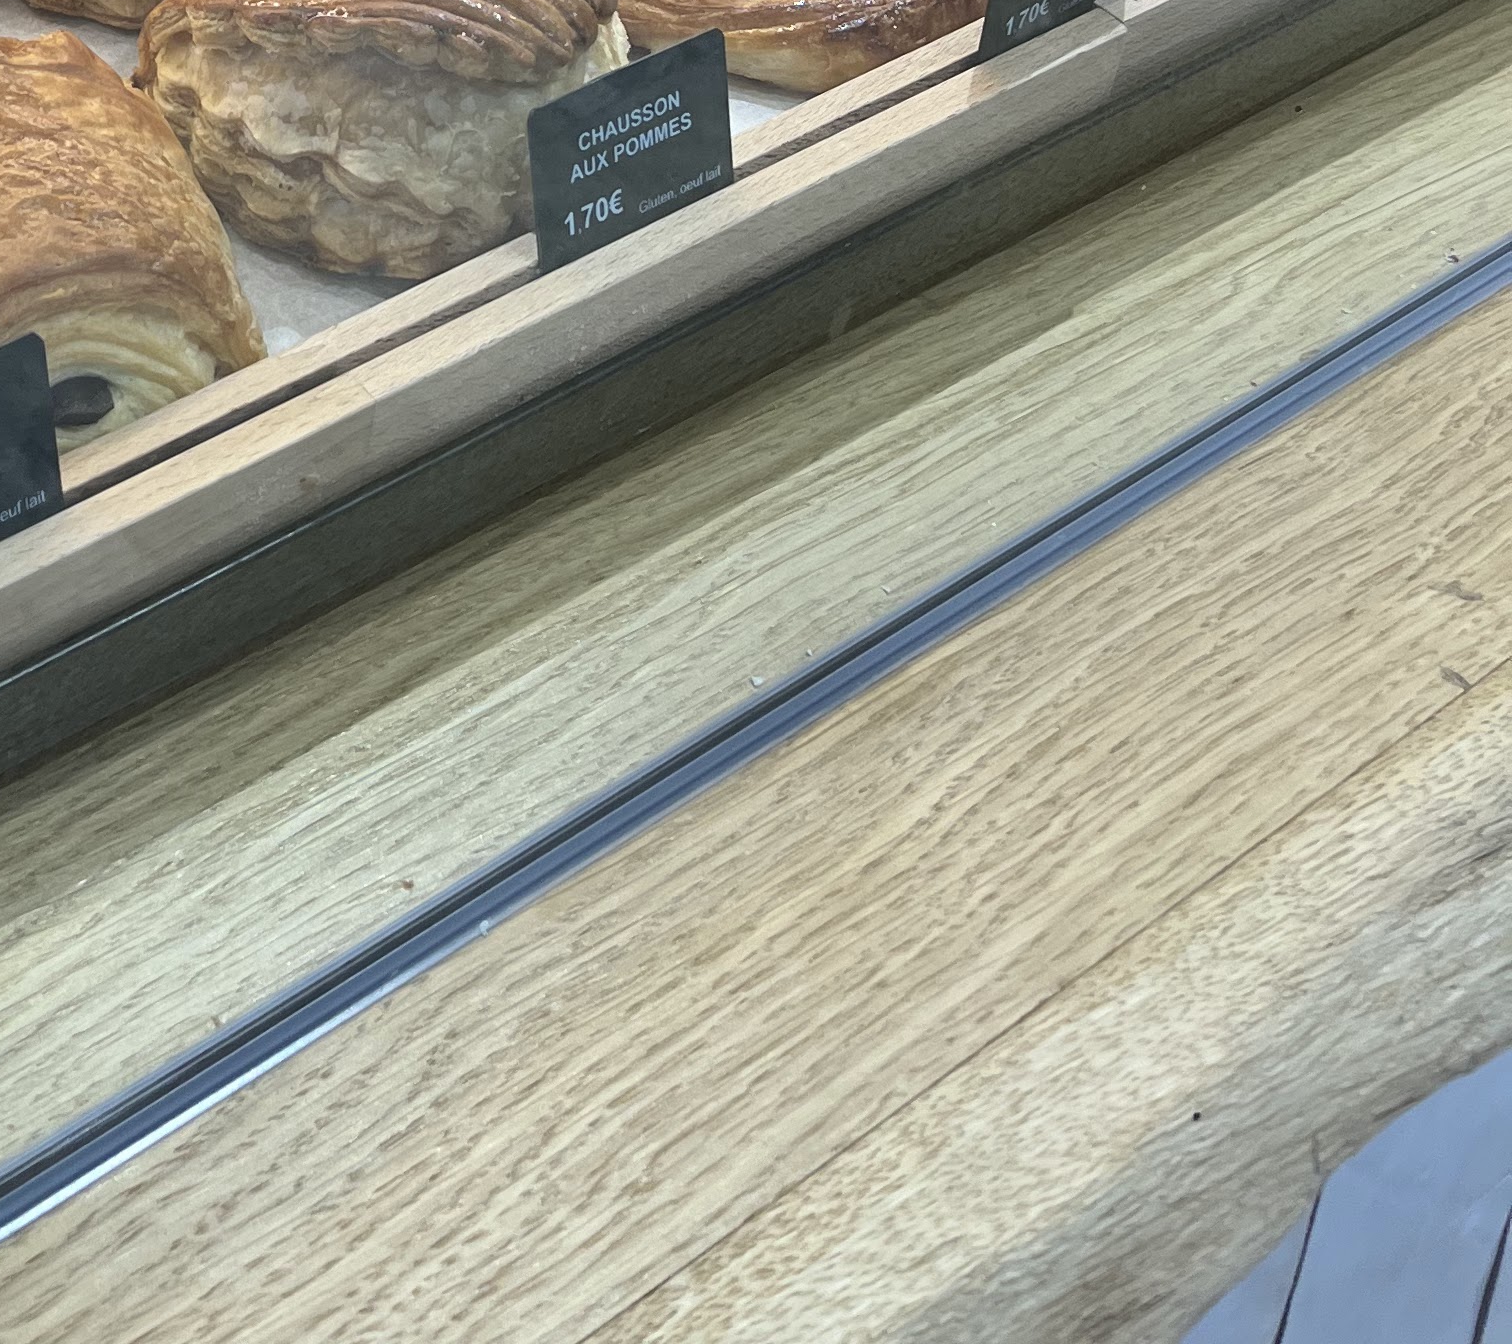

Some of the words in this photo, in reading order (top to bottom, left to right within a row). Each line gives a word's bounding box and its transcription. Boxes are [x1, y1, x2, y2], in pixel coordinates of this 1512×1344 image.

[578, 90, 680, 151] CHAUSSON
[570, 150, 609, 184] AUX
[613, 112, 692, 163] POMMES
[679, 173, 704, 195] oeuf
[705, 165, 721, 183] lait
[564, 188, 624, 236] 1,70€
[25, 489, 46, 511] lait
